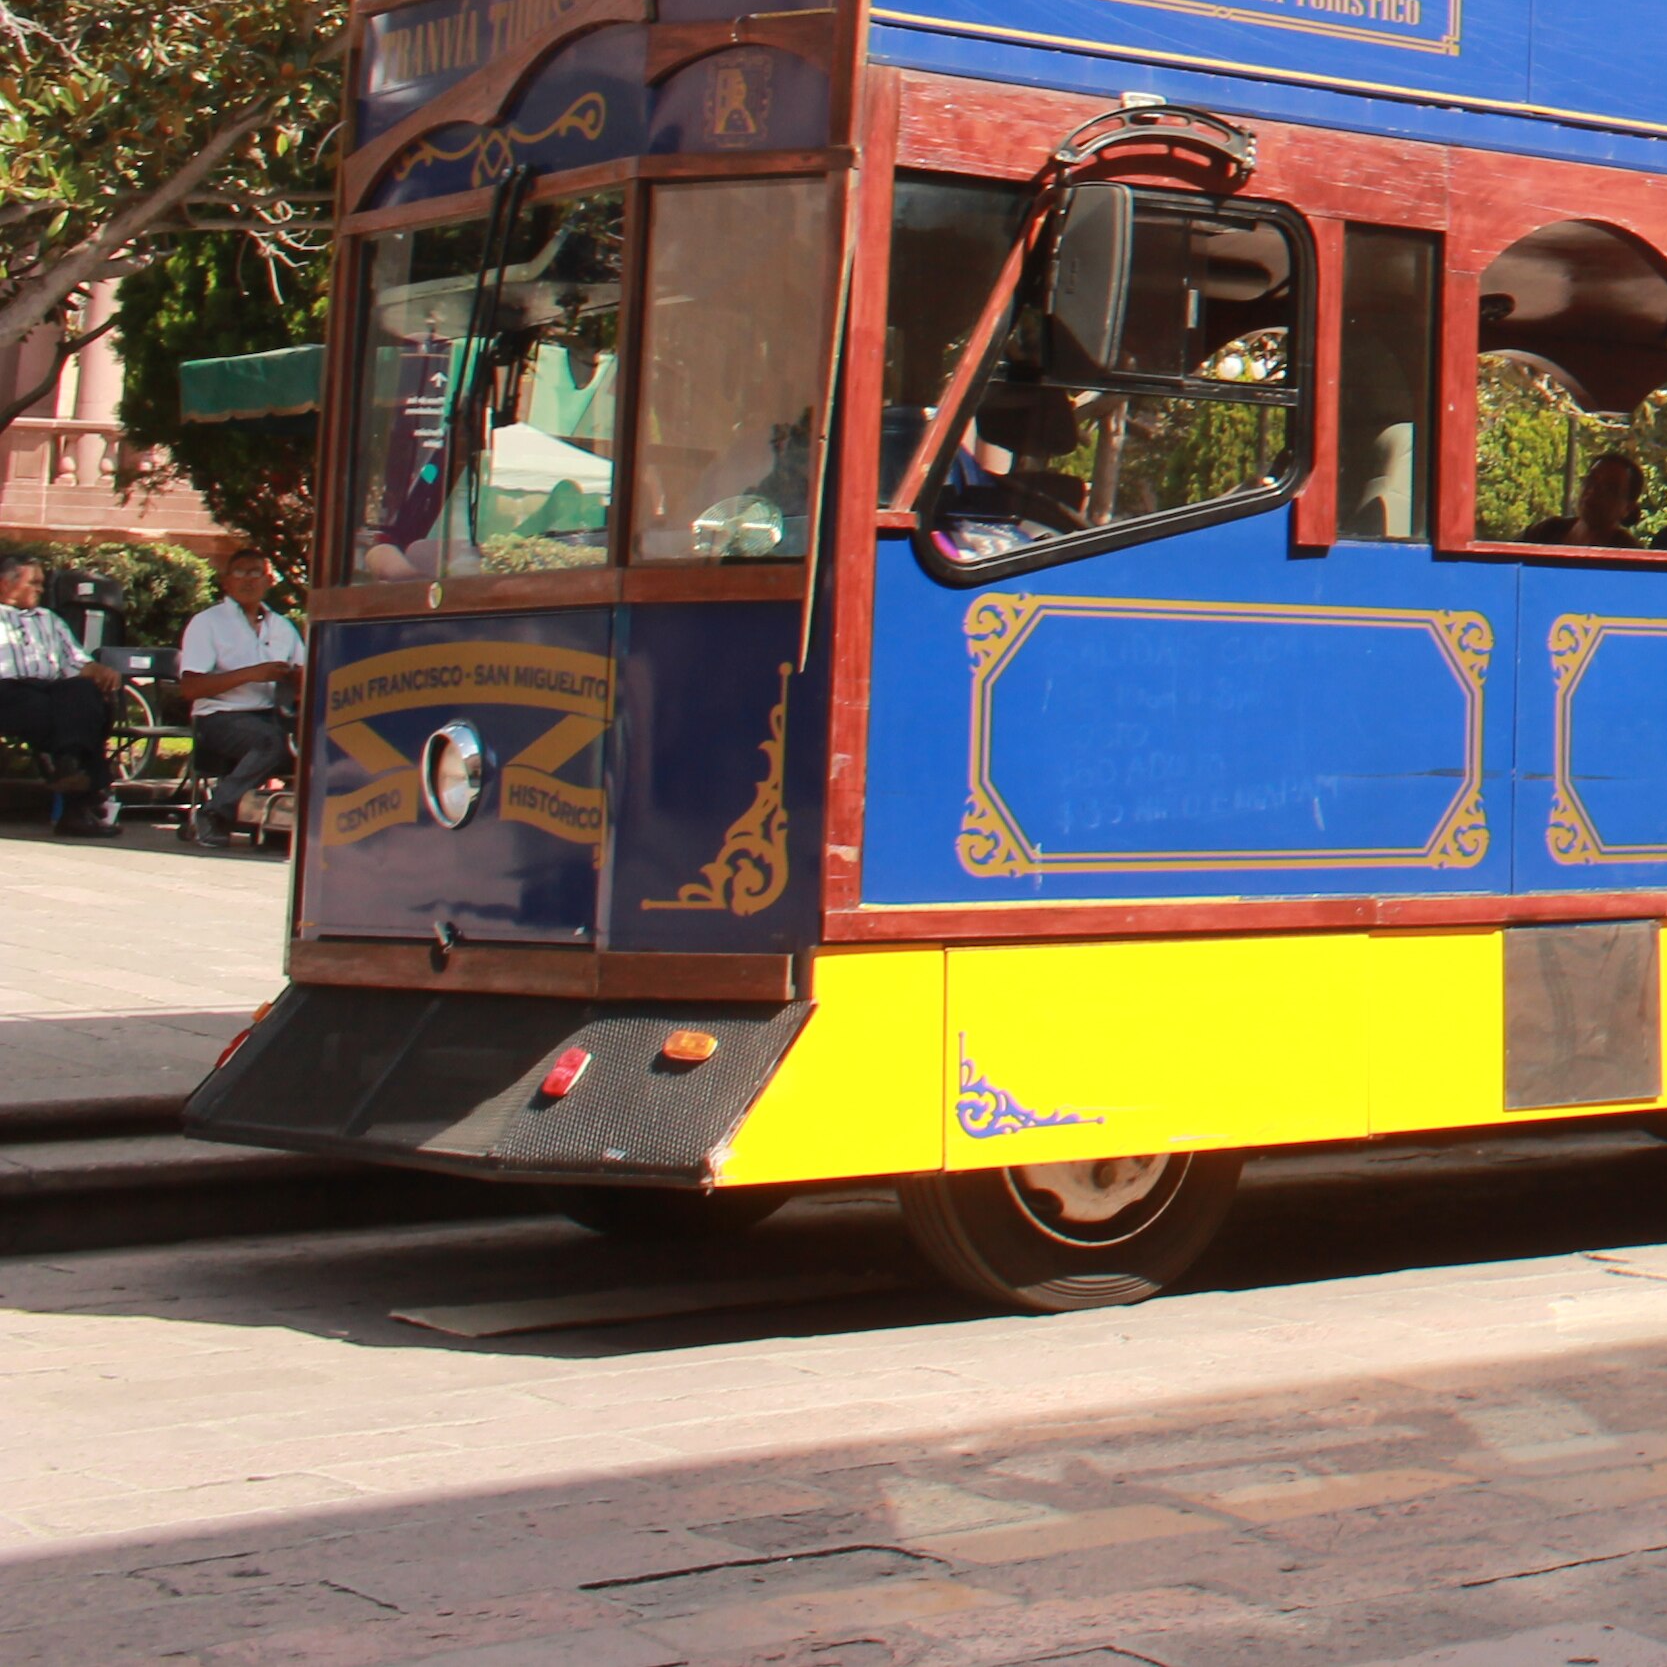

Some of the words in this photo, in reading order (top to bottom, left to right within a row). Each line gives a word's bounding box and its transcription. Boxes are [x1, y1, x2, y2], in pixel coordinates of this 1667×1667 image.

[331, 682, 364, 711] SAN
[367, 665, 463, 699] FRANCISCO
[474, 664, 510, 686] SAN
[514, 665, 609, 702] MIGUELITO
[336, 789, 401, 833] CENTRO
[508, 784, 601, 830] HISTÓRICO
